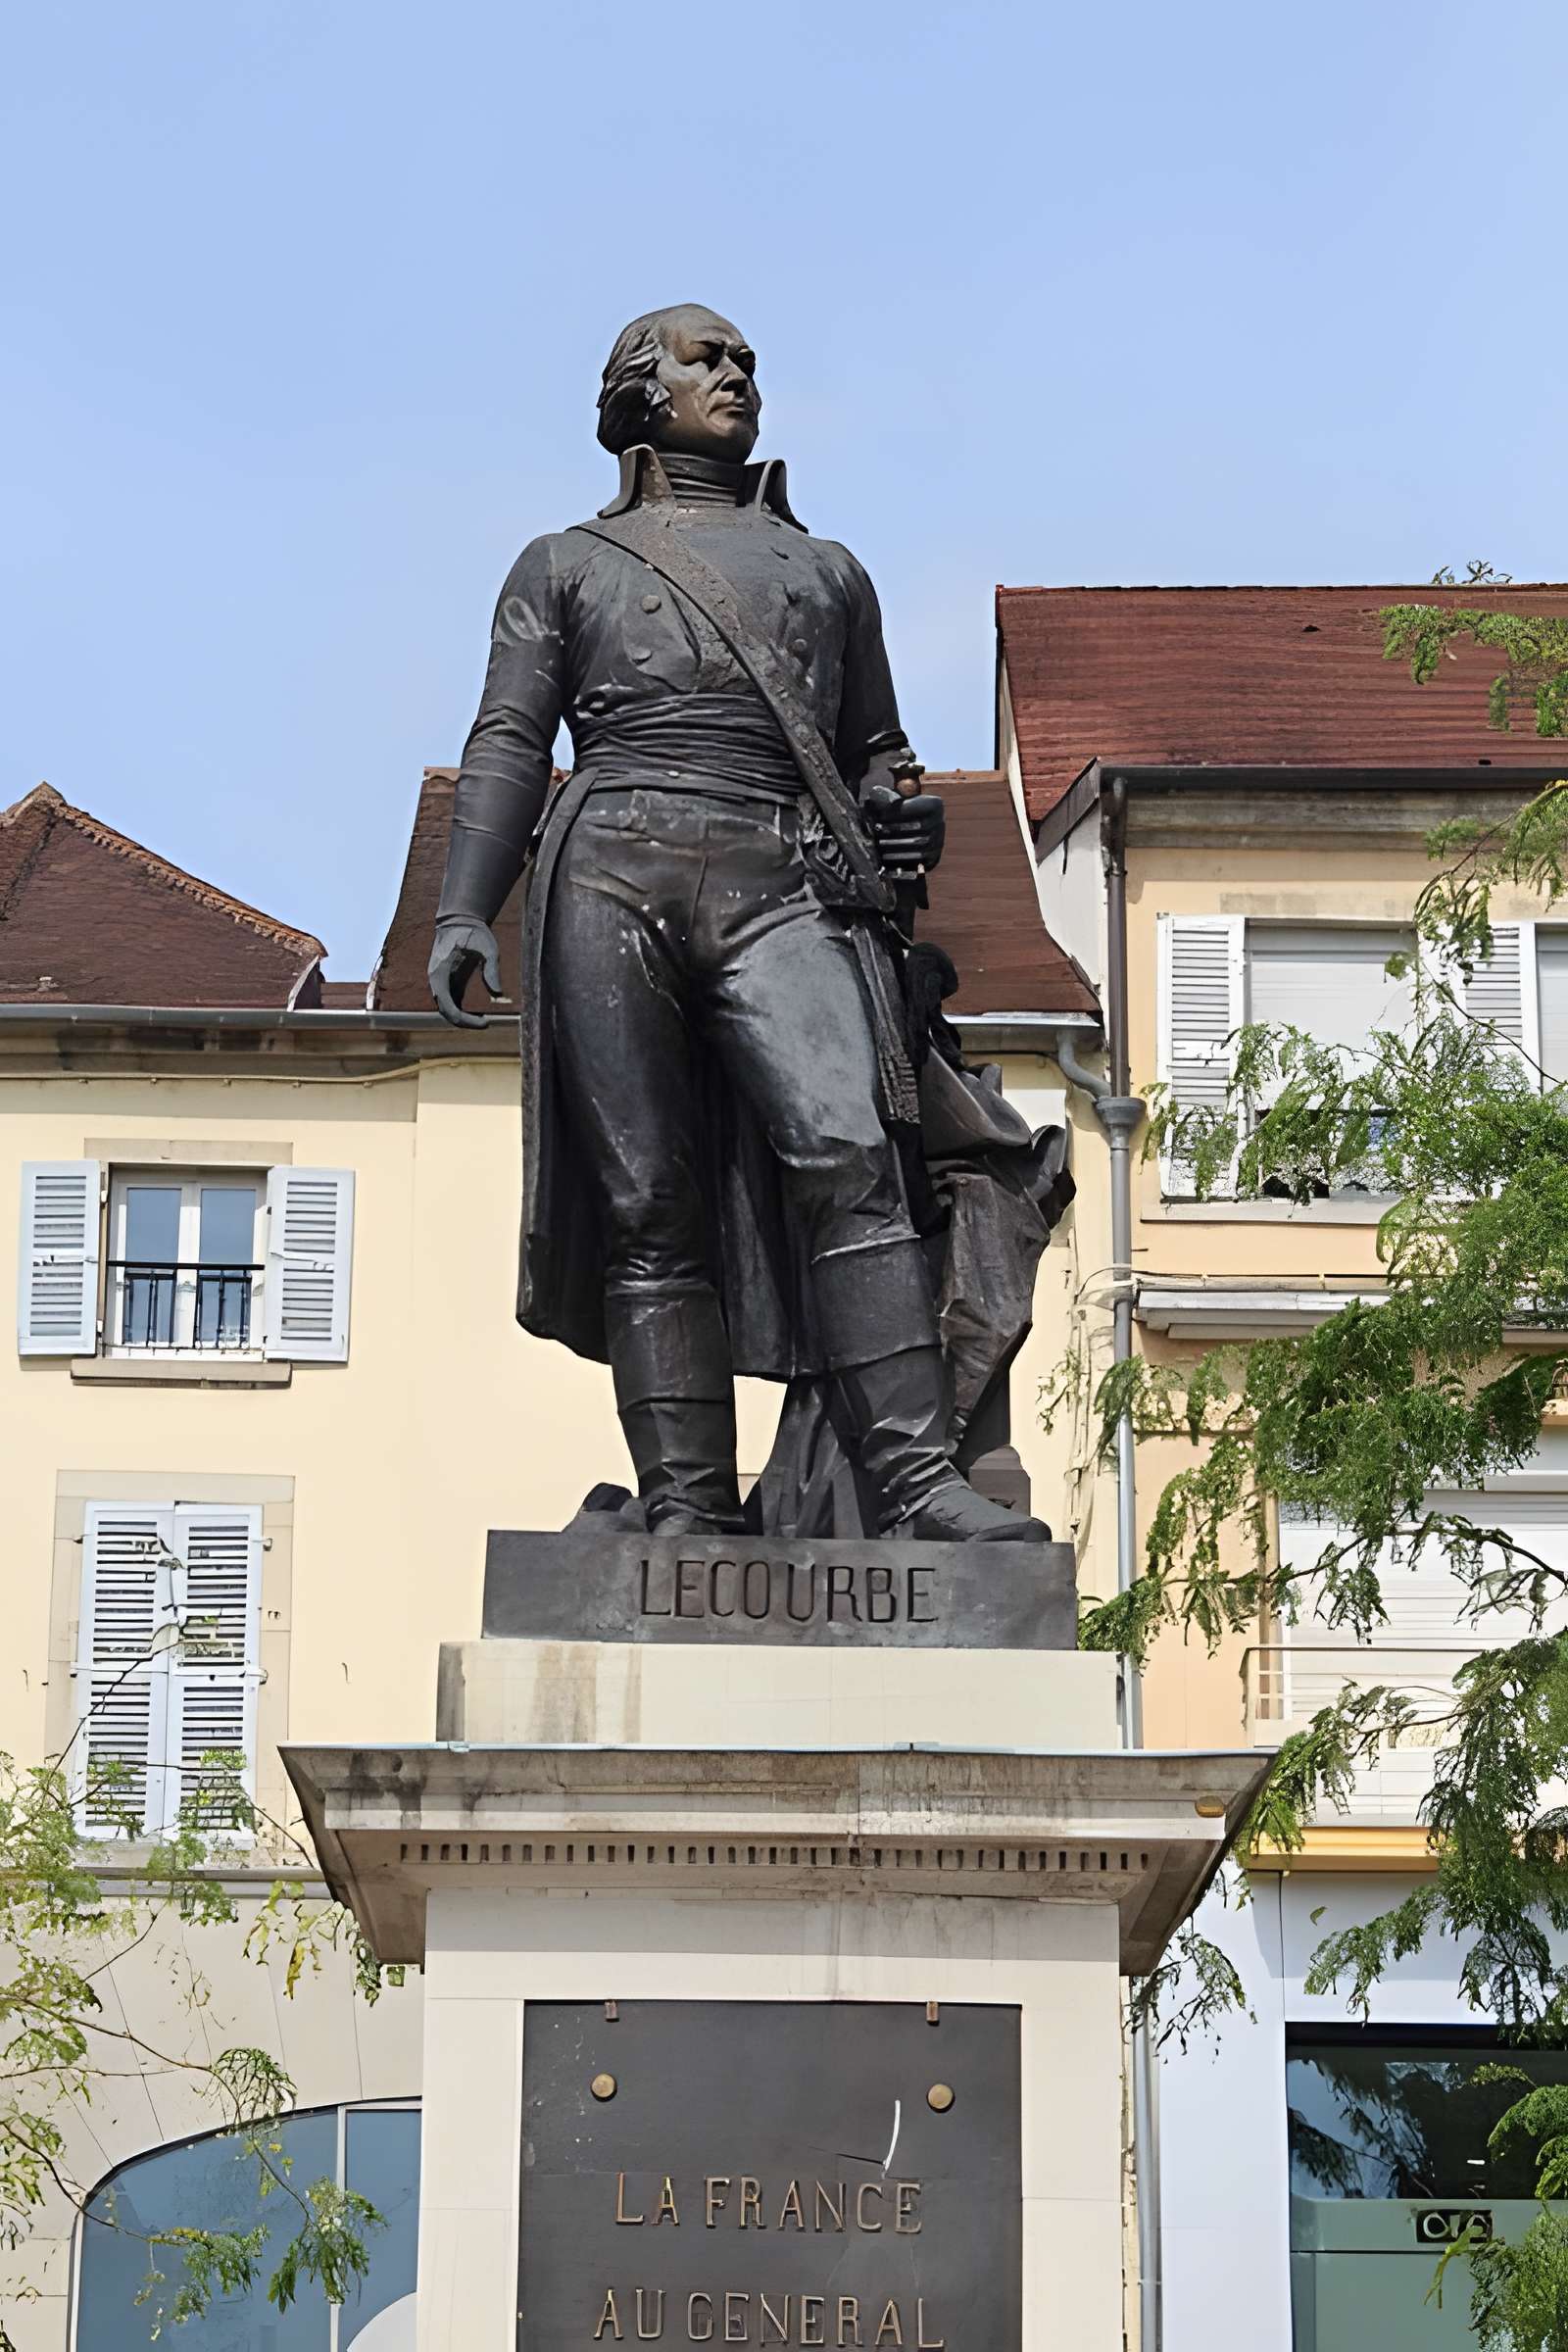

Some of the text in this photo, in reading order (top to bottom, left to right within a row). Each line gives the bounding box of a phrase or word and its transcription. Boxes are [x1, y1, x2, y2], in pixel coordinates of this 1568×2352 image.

[639, 1558, 939, 1623] LECOURBE
[615, 2172, 923, 2233] LA FRANCE
[593, 2287, 945, 2348] AU GENERAL
